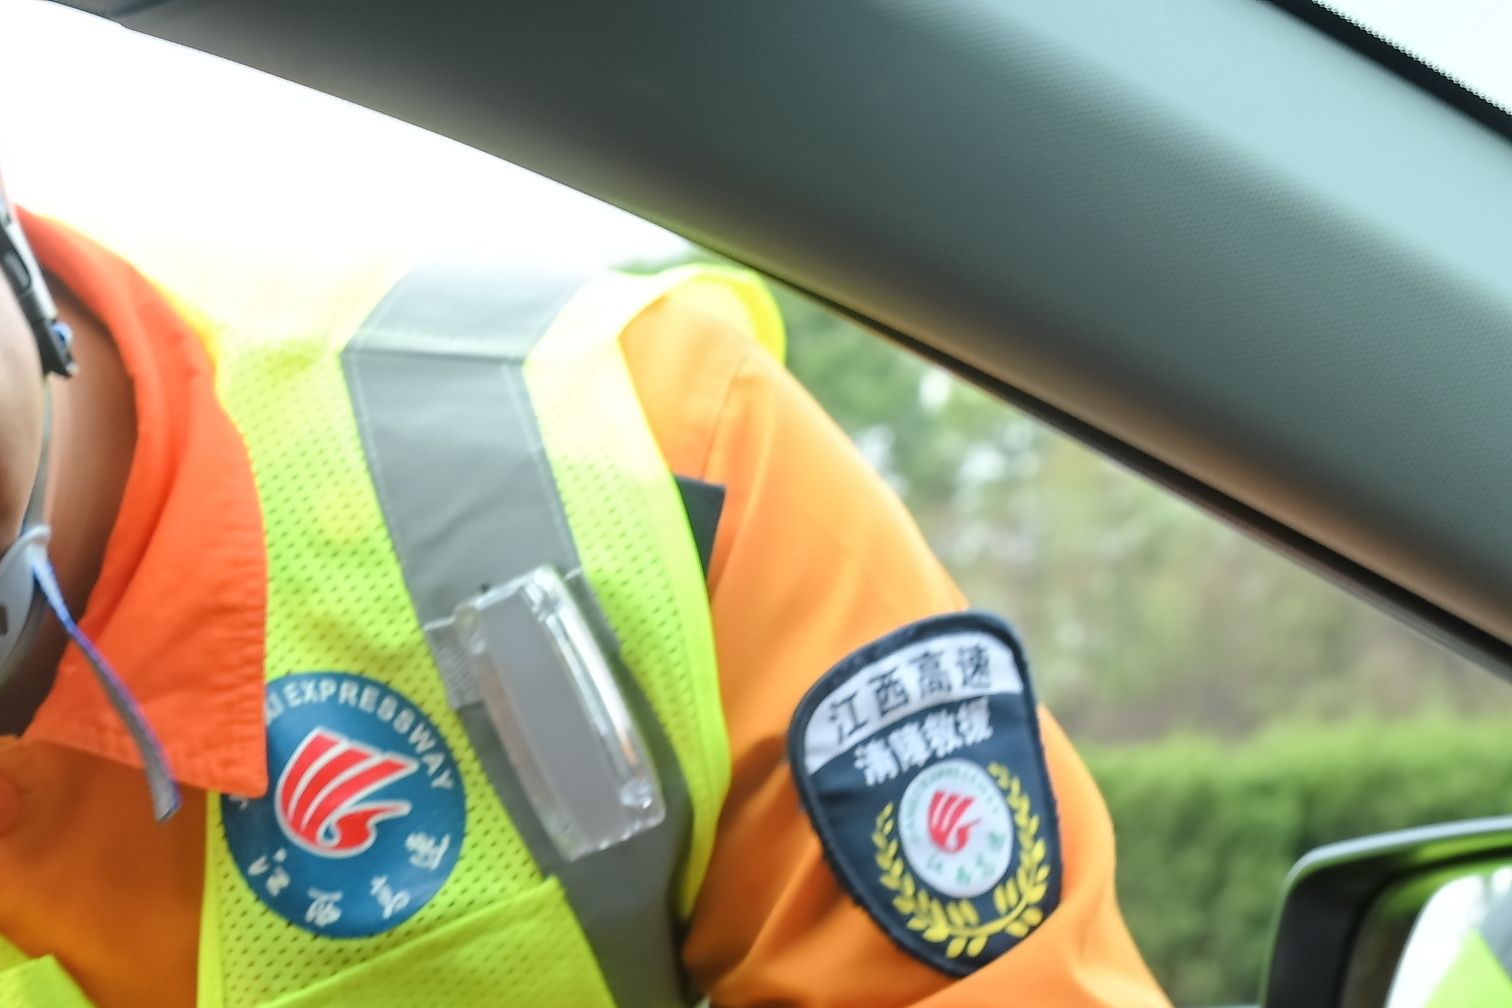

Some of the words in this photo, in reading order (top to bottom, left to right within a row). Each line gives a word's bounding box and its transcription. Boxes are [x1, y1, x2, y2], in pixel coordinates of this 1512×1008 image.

[283, 678, 454, 790] EXPRESSWAY
[828, 644, 992, 743] 江西高速
